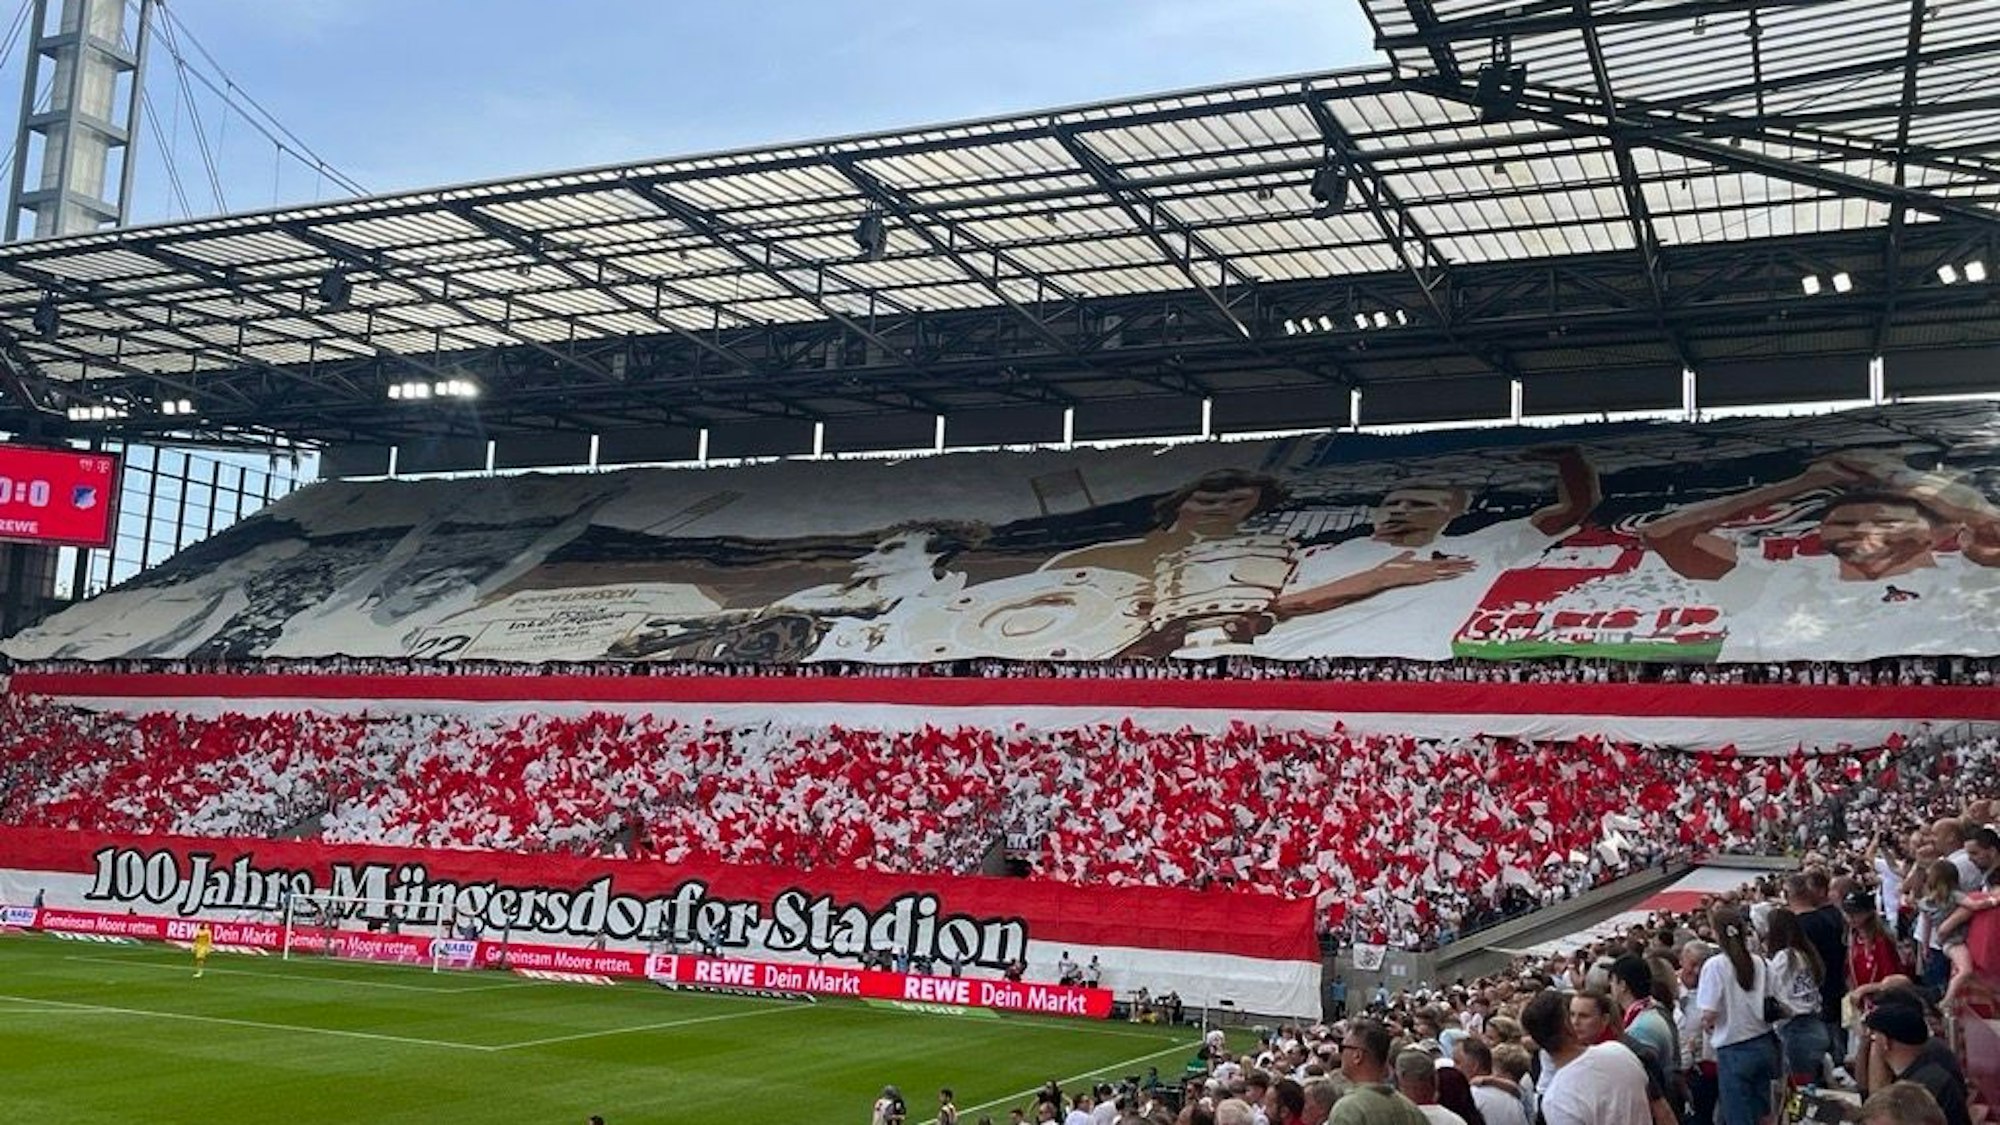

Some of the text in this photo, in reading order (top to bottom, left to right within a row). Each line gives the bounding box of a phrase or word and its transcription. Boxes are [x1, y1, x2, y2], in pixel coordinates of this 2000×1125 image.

[86, 846, 180, 903] 100
[330, 862, 759, 946] Müngersdorfer
[762, 886, 1027, 970] Stadion
[43, 912, 95, 931] Gemeinsam
[95, 916, 126, 934] Moore
[167, 920, 277, 946] REW Dein Markt
[289, 931, 346, 950] Gemeinam
[554, 950, 593, 970] Moore
[594, 957, 633, 973] retten.
[695, 960, 755, 985] REWE
[764, 965, 802, 989] Dein
[806, 968, 860, 993] Markt
[904, 977, 970, 1003] REWE
[981, 982, 1024, 1007] Dein
[1027, 986, 1087, 1014] Markt
